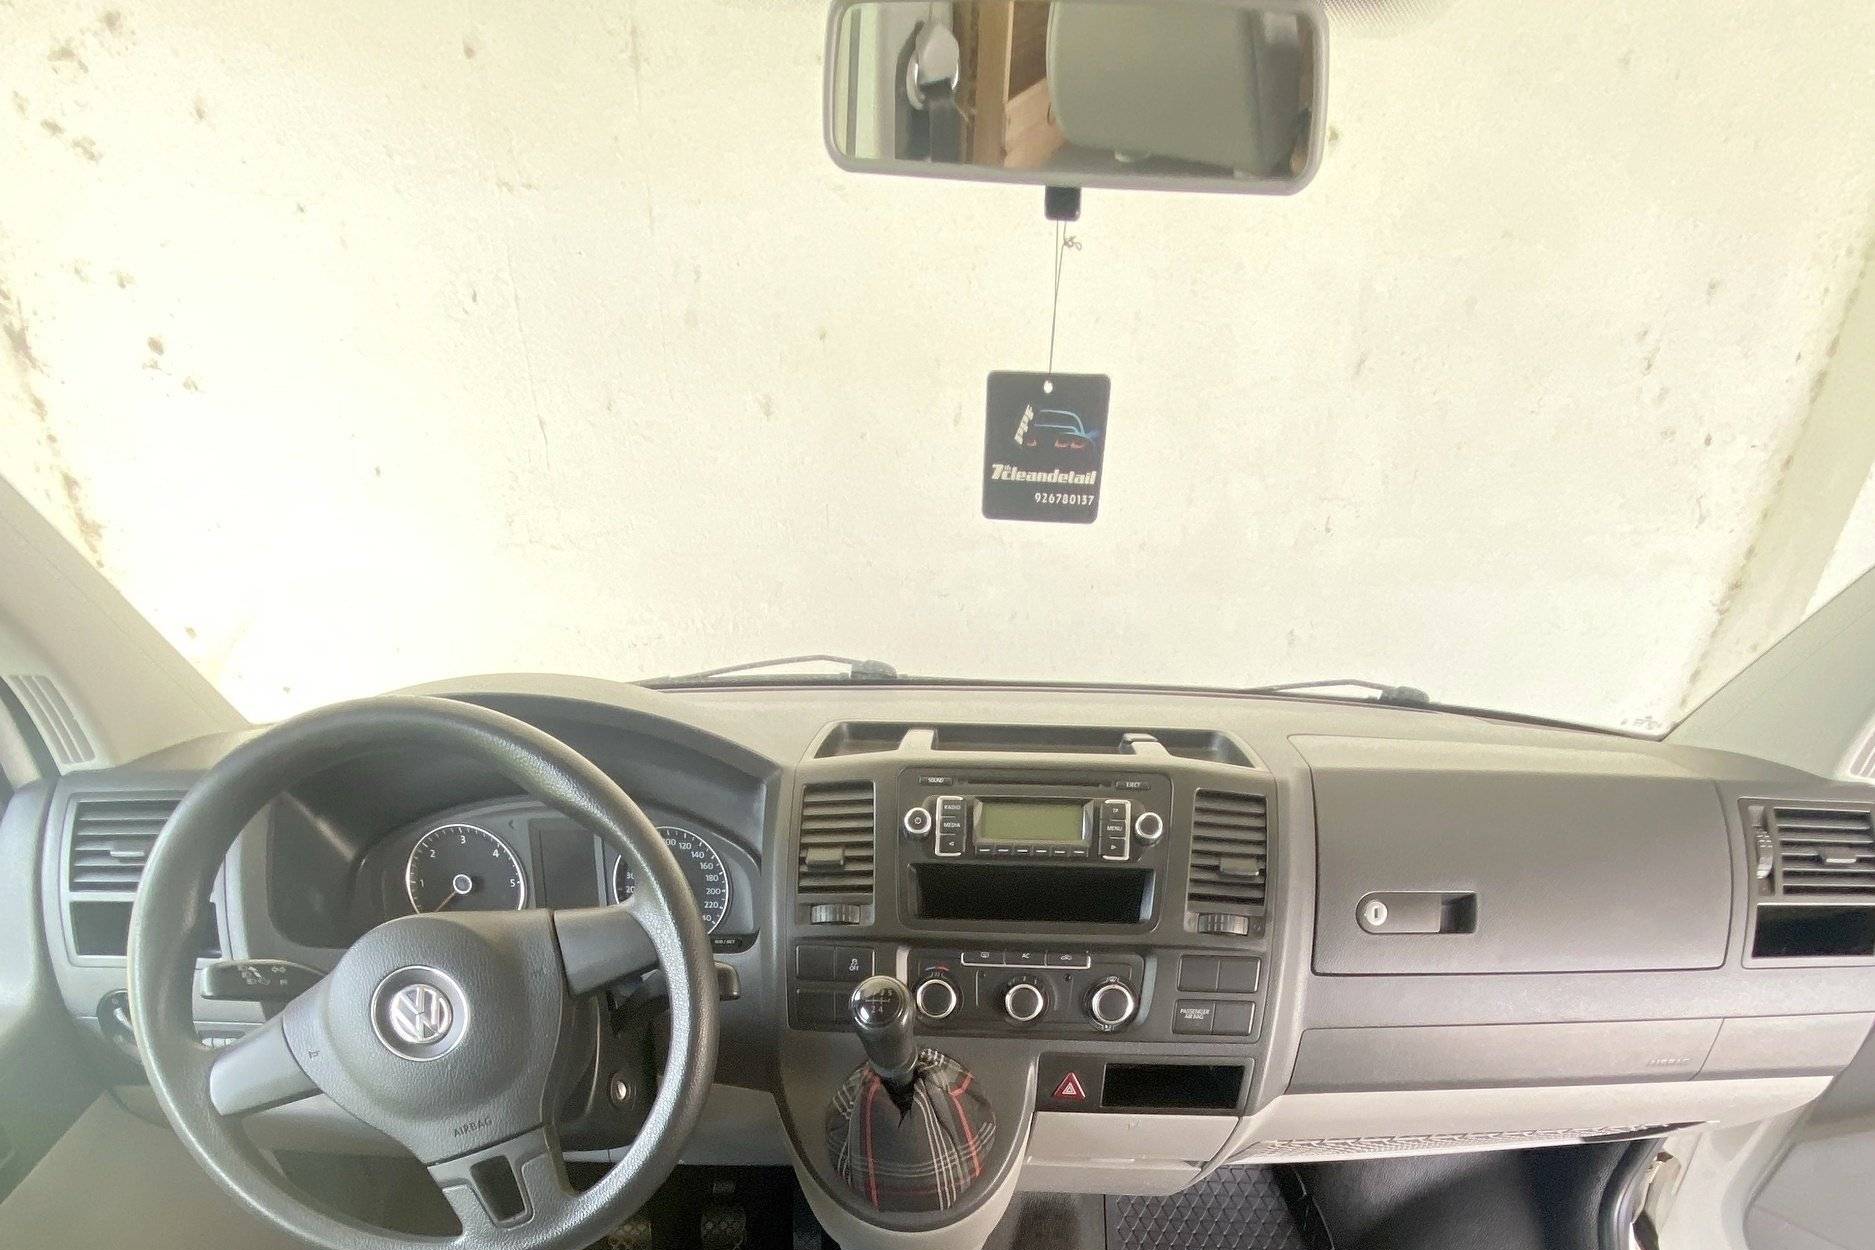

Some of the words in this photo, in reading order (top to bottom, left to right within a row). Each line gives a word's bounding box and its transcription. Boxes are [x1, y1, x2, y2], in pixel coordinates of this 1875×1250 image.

[1034, 492, 1095, 506] 926780137
[460, 835, 466, 844] 3
[679, 842, 692, 850] 120
[430, 849, 436, 858] 2
[492, 848, 500, 858] 4
[691, 851, 705, 859] 140
[700, 862, 714, 870] 160
[705, 874, 719, 882] 180
[510, 878, 516, 888] 5
[706, 887, 721, 895] 200
[704, 901, 719, 909] 220
[453, 1117, 493, 1138] AIRBAG
